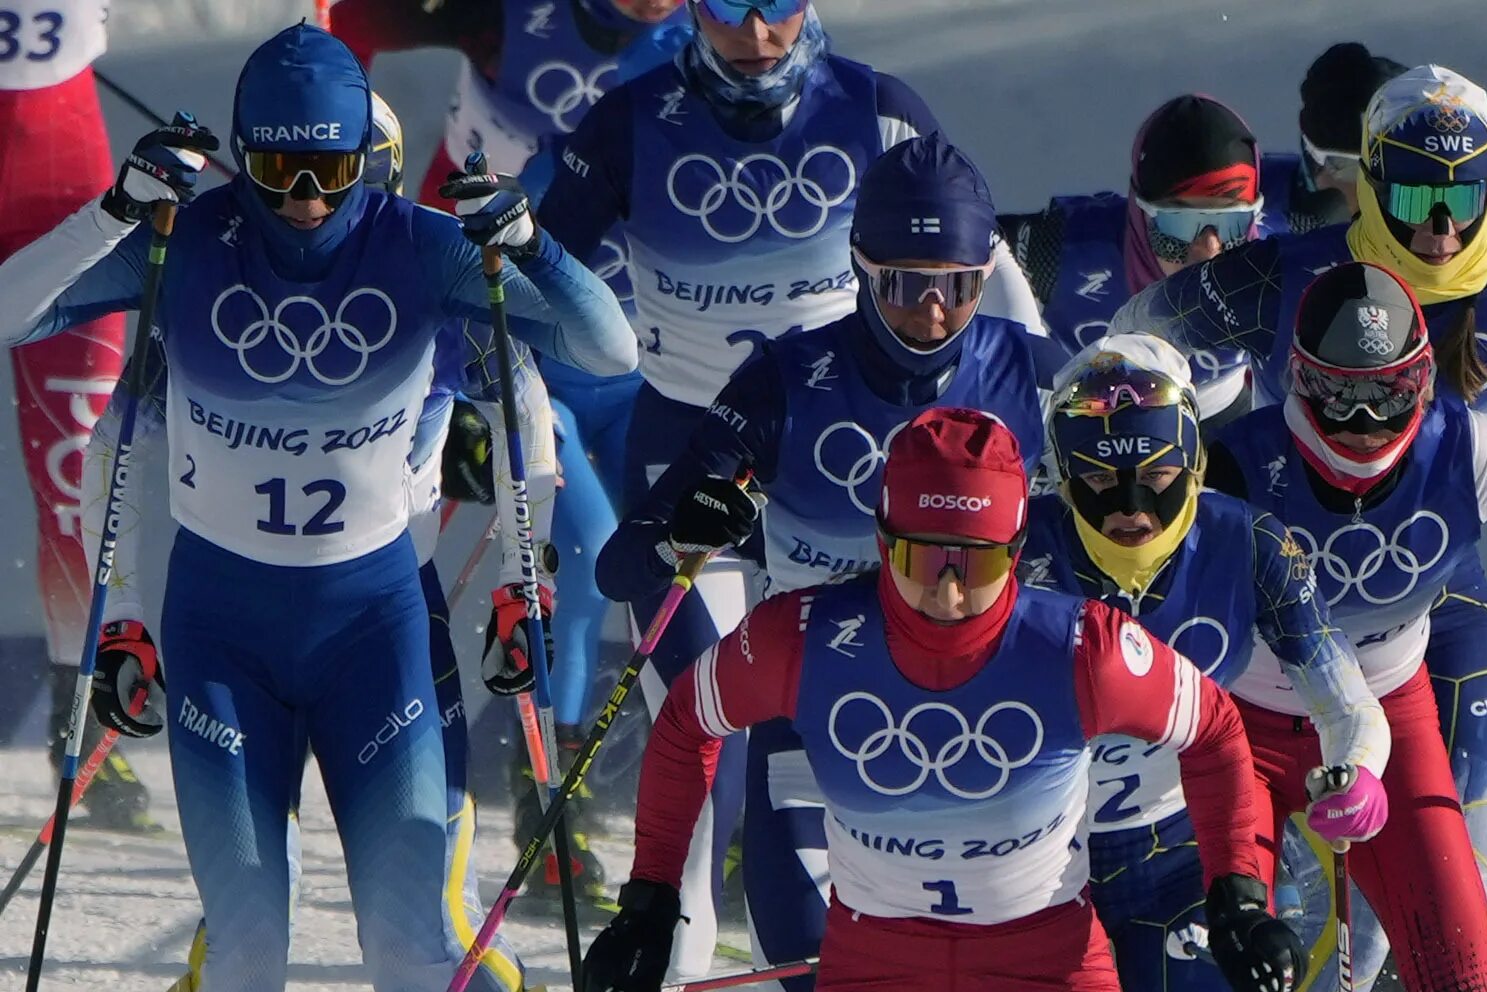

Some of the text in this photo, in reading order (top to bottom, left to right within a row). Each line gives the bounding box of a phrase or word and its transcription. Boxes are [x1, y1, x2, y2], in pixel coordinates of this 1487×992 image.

[253, 123, 341, 141] FRANCE
[1425, 136, 1474, 152] SWE
[655, 269, 774, 312] BEIJING
[188, 398, 408, 455] BEIJING 2022
[1097, 436, 1151, 457] SWE
[254, 477, 347, 536] 12
[694, 491, 729, 515] HESTRA
[918, 493, 983, 512] BOSCO
[595, 667, 637, 730] LEKI
[179, 696, 246, 755] FRANCE
[358, 699, 424, 764] odlo
[1094, 774, 1142, 823] 2
[922, 880, 974, 916] 1
